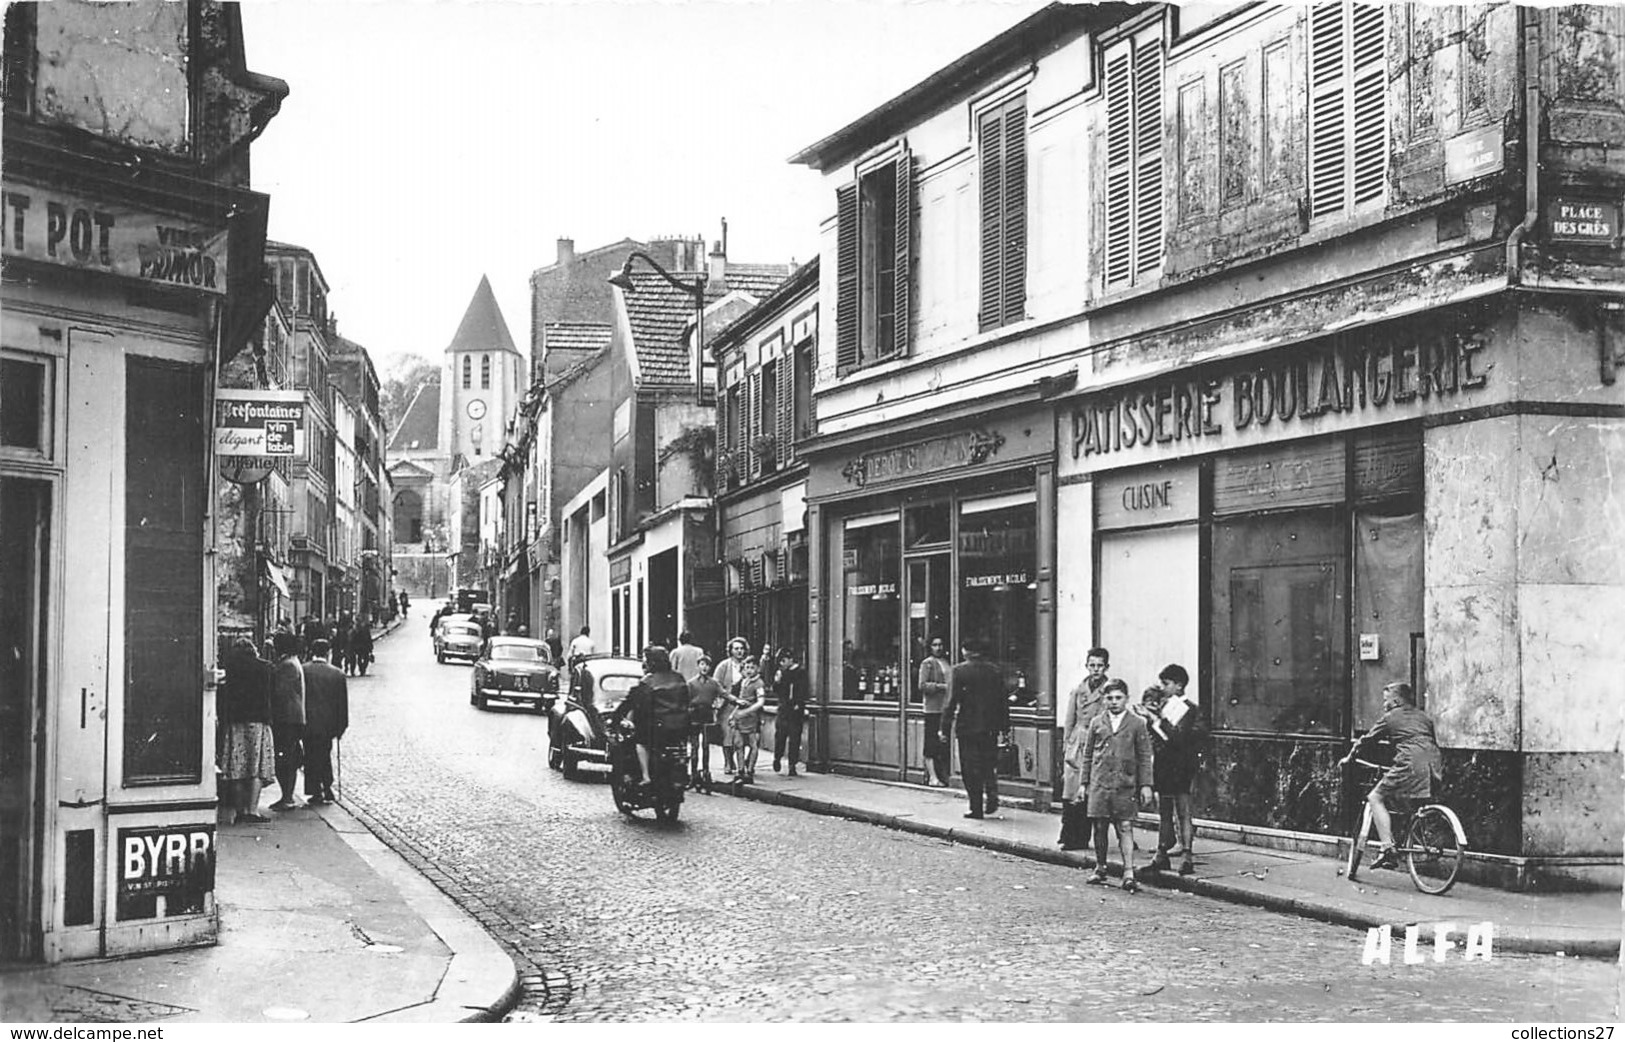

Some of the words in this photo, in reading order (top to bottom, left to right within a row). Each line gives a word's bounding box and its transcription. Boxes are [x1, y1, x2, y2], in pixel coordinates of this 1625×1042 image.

[1561, 206, 1602, 218] PLACE
[48, 200, 115, 266] POT
[1554, 221, 1576, 234] DES
[1232, 338, 1487, 429] BOULANGERIE
[268, 422, 287, 432] vin
[1071, 383, 1222, 459] PATISSERIE
[267, 432, 283, 442] de
[1122, 481, 1173, 511] CUISINE
[124, 831, 217, 880] BYRR
